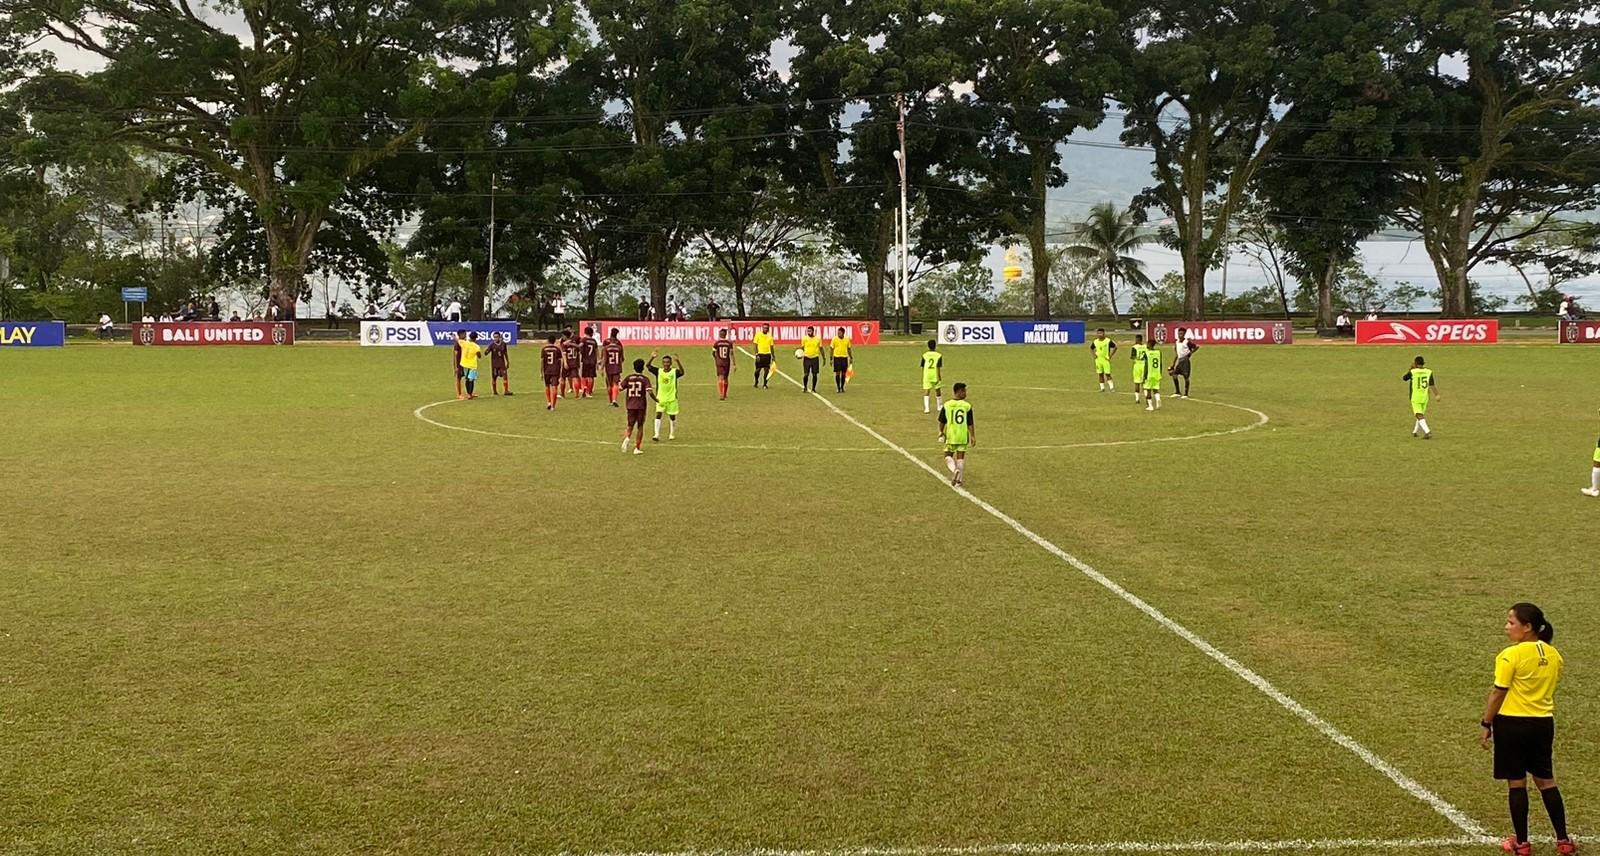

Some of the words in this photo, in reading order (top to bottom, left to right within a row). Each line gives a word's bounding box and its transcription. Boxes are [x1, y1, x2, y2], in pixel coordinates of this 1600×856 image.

[163, 328, 200, 342] BALI
[204, 328, 264, 342] UNITED
[387, 327, 421, 341] PSSI
[607, 326, 652, 341] KMPETISI
[962, 326, 994, 340] PSSI
[1023, 331, 1069, 344] MALUKU
[1211, 328, 1266, 340] UNITED
[1425, 324, 1488, 341] SPECS
[588, 344, 594, 356] 7
[719, 346, 728, 359] 18
[547, 352, 554, 365] 3
[608, 352, 619, 365] 21
[928, 358, 935, 369] 2
[1152, 357, 1159, 369] 8
[628, 381, 642, 397] 22
[1417, 376, 1428, 389] 15
[950, 409, 965, 425] 16
